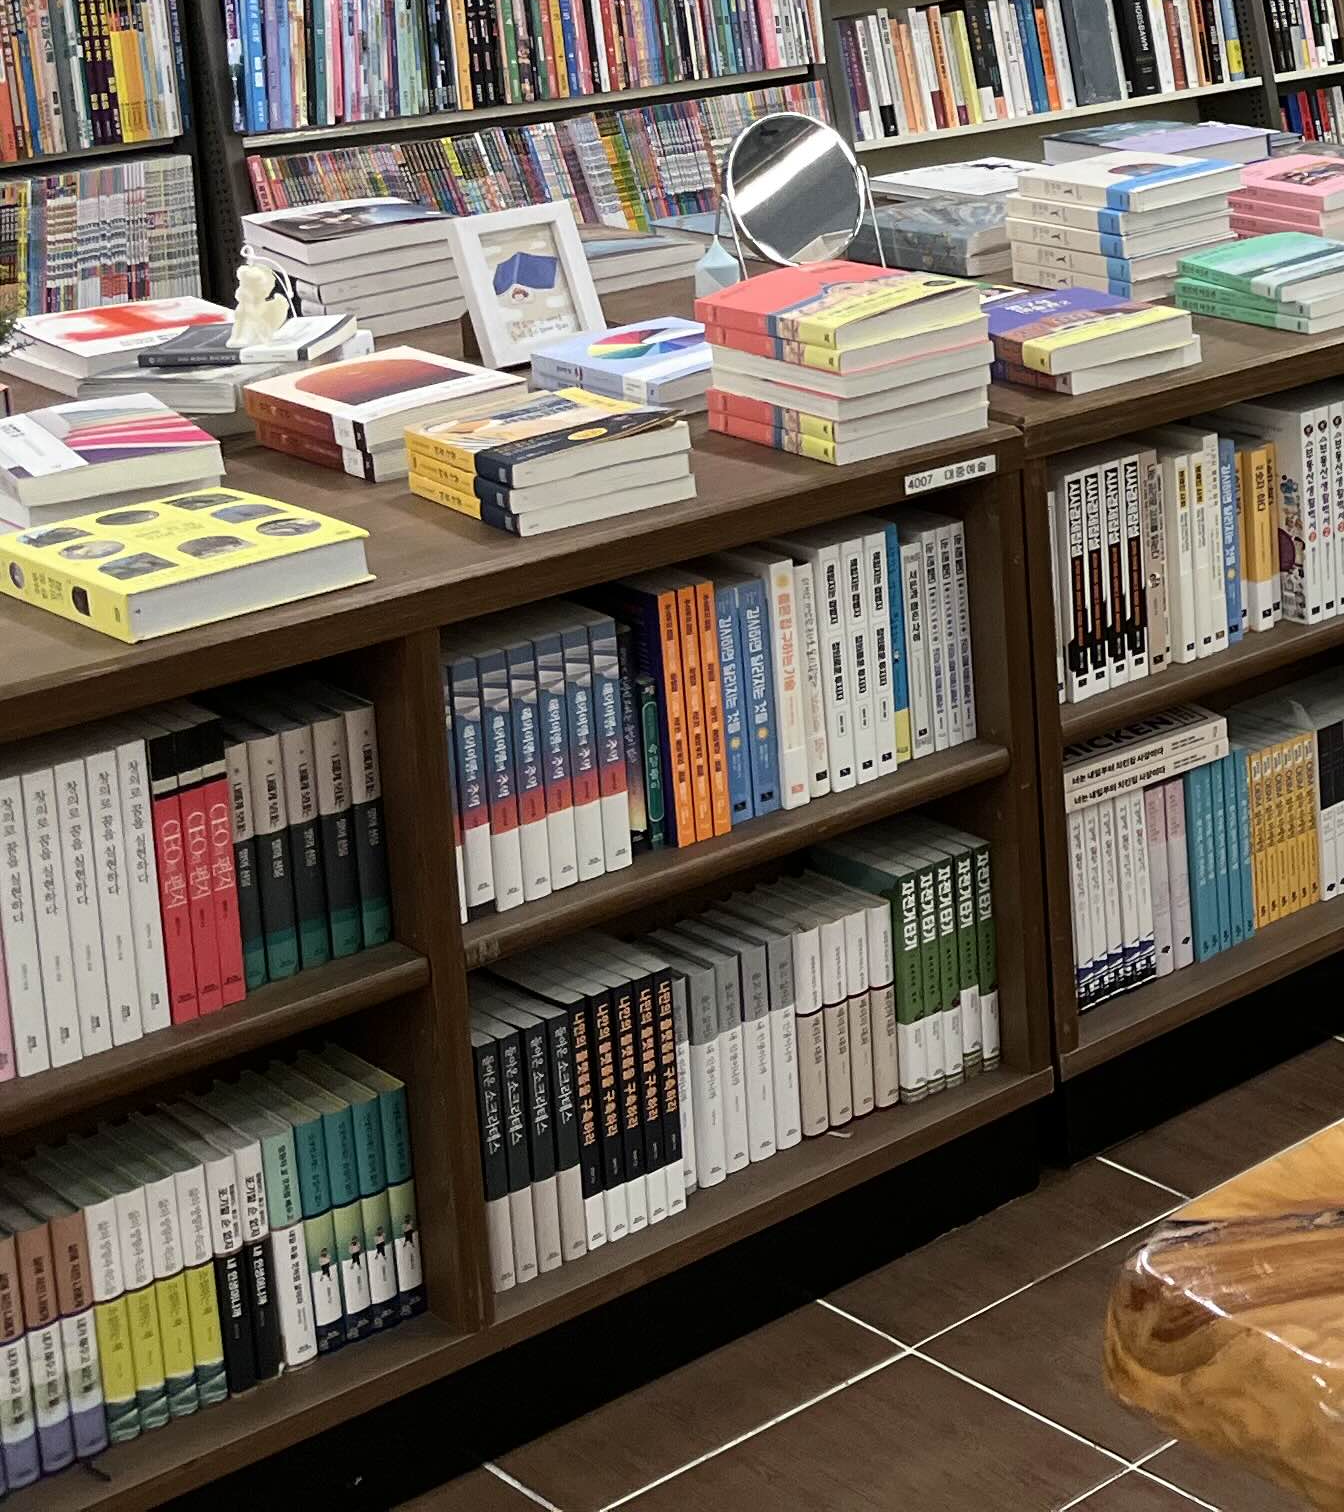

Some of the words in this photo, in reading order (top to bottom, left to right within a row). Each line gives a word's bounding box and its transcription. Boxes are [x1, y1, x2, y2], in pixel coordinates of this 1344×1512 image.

[1134, 2, 1149, 50] HOBSBAWM
[907, 475, 934, 490] 4007
[1124, 464, 1140, 538] 시사경제잡설
[1068, 482, 1083, 558] 시사경제잡설
[1085, 476, 1100, 551] 시사경제잡설
[1105, 471, 1120, 545] 시사경제잡설
[1223, 505, 1234, 544] 달라지는
[718, 616, 735, 662] 감사하면
[745, 606, 763, 653] 감사하면
[723, 664, 738, 710] 달라지는
[749, 654, 765, 700] 달라지는
[726, 711, 741, 734] 것들
[753, 701, 768, 725] 것들
[1072, 775, 1086, 785] 너는
[1087, 764, 1115, 778] 내일부터
[1116, 755, 1136, 769] 치킨집
[1137, 746, 1164, 761] 사장이다
[1074, 795, 1088, 804] 너는
[1089, 784, 1117, 798] 내일부터
[1118, 775, 1138, 789] 치킨집
[1139, 765, 1166, 781] 사장이다
[597, 1004, 611, 1040] 나만의
[618, 996, 632, 1032] 나만의
[639, 989, 653, 1024] 나만의
[657, 981, 671, 1017] 나만의
[508, 1081, 525, 1146] 소크라테스
[533, 1071, 550, 1136] 소크라테스
[556, 1061, 573, 1124] 소크라테스
[603, 1090, 618, 1137] 구축하라
[624, 1082, 638, 1129] 구축하라
[644, 1075, 659, 1121] 구축하라
[663, 1068, 678, 1113] 구축하라
[483, 1091, 501, 1155] 소크라테스
[218, 1188, 232, 1216] 포기할
[245, 1176, 258, 1204] 포기할
[222, 1230, 236, 1250] 없지
[248, 1219, 261, 1238] 없지
